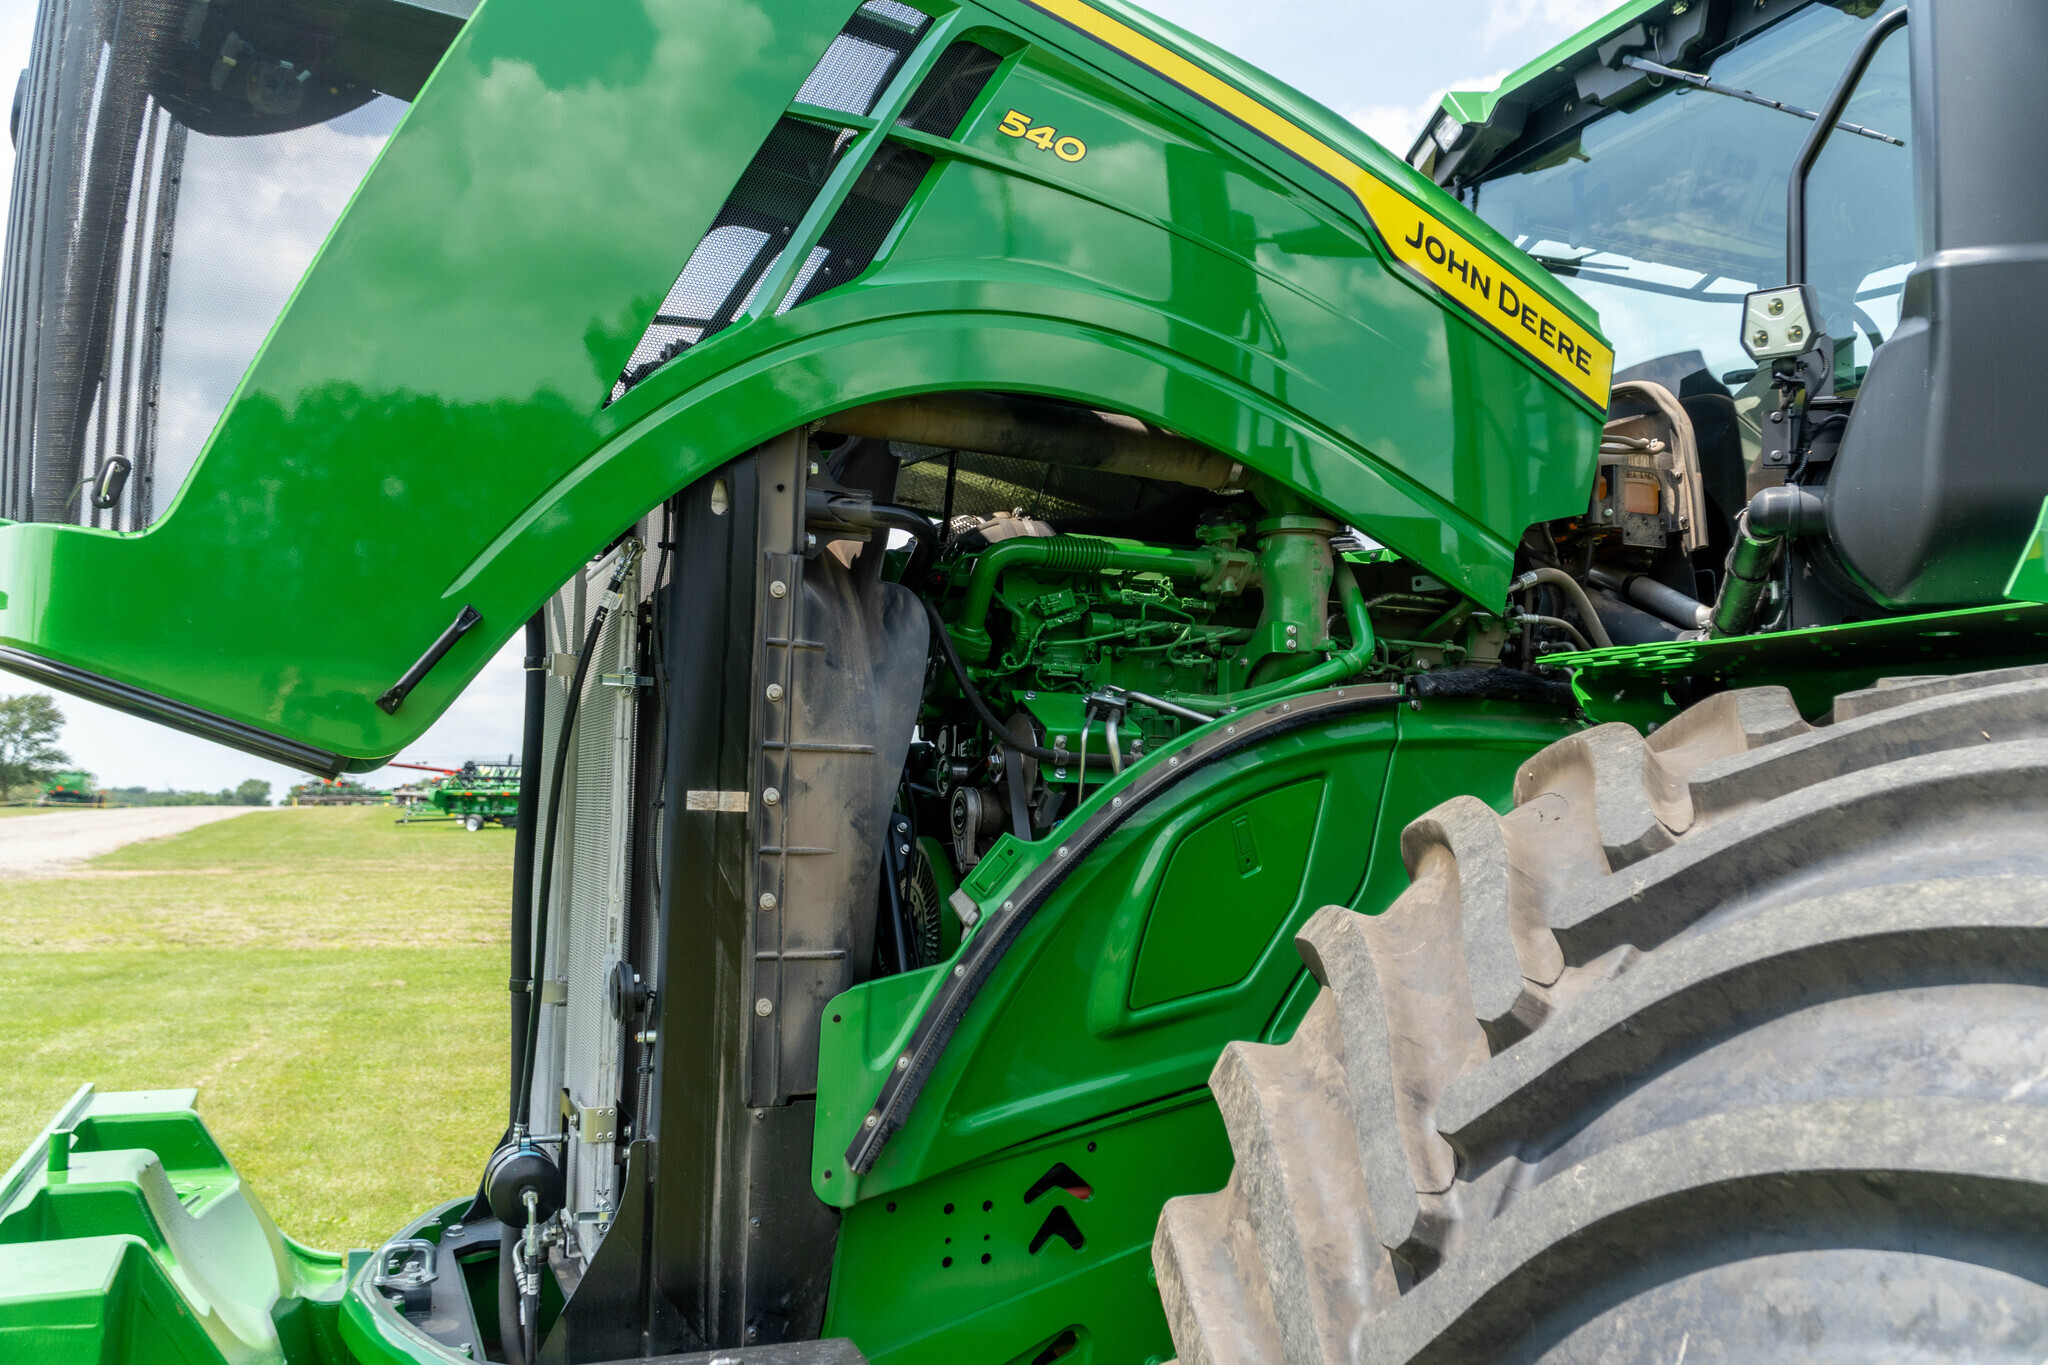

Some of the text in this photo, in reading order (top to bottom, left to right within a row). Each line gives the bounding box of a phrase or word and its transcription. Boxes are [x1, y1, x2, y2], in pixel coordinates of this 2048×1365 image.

[997, 108, 1087, 163] 540
[1405, 221, 1592, 376] JOHN DEERE
